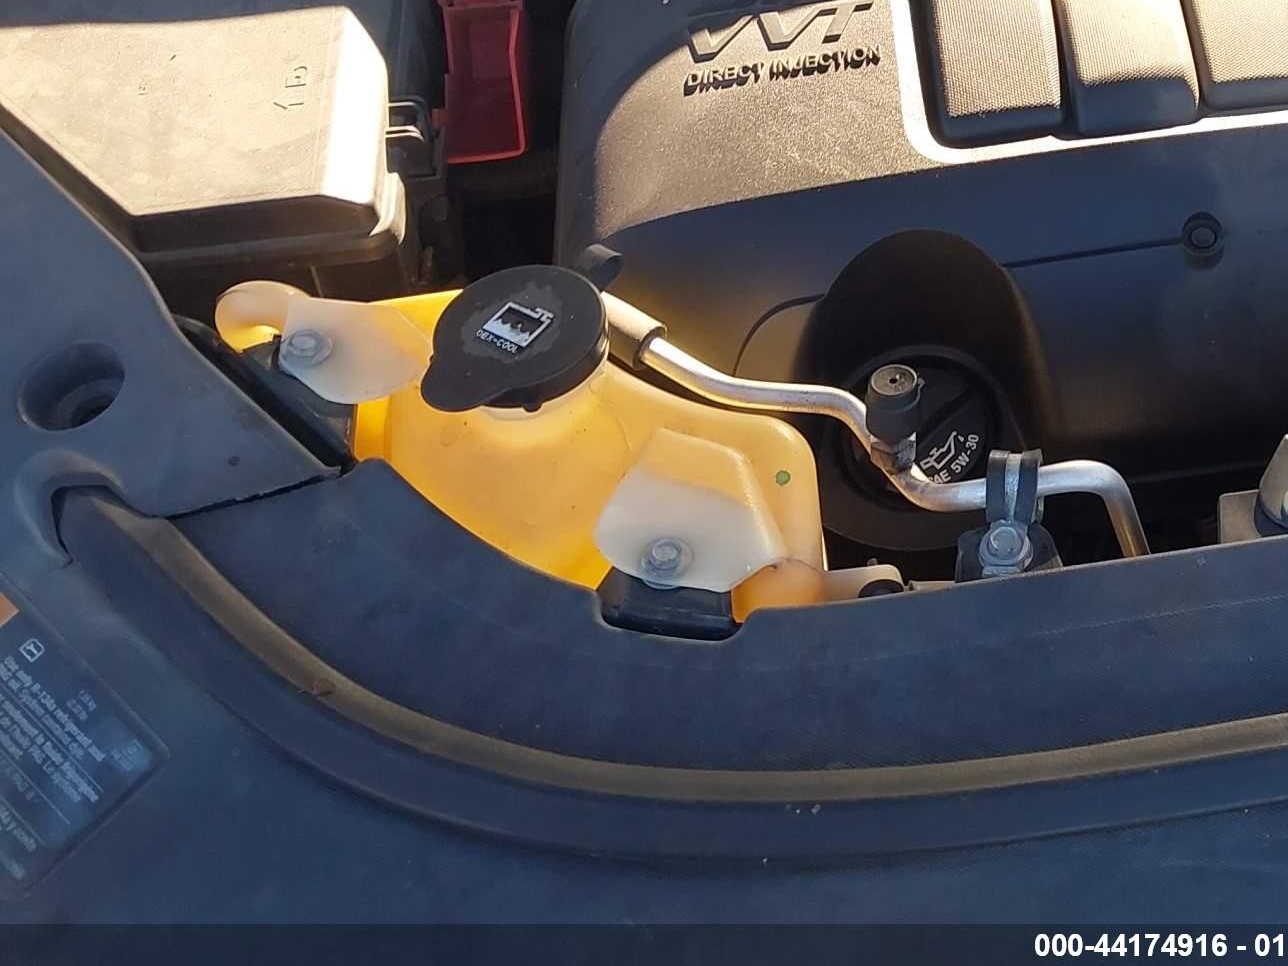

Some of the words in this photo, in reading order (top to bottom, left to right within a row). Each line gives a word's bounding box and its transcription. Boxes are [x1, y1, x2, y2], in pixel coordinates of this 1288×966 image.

[687, 0, 873, 63] VVT
[684, 61, 766, 97] DIRECT
[769, 45, 881, 81] INJECTION
[476, 329, 518, 354] DEX-COOL
[928, 470, 952, 484] AE
[951, 434, 979, 474] 5W-30
